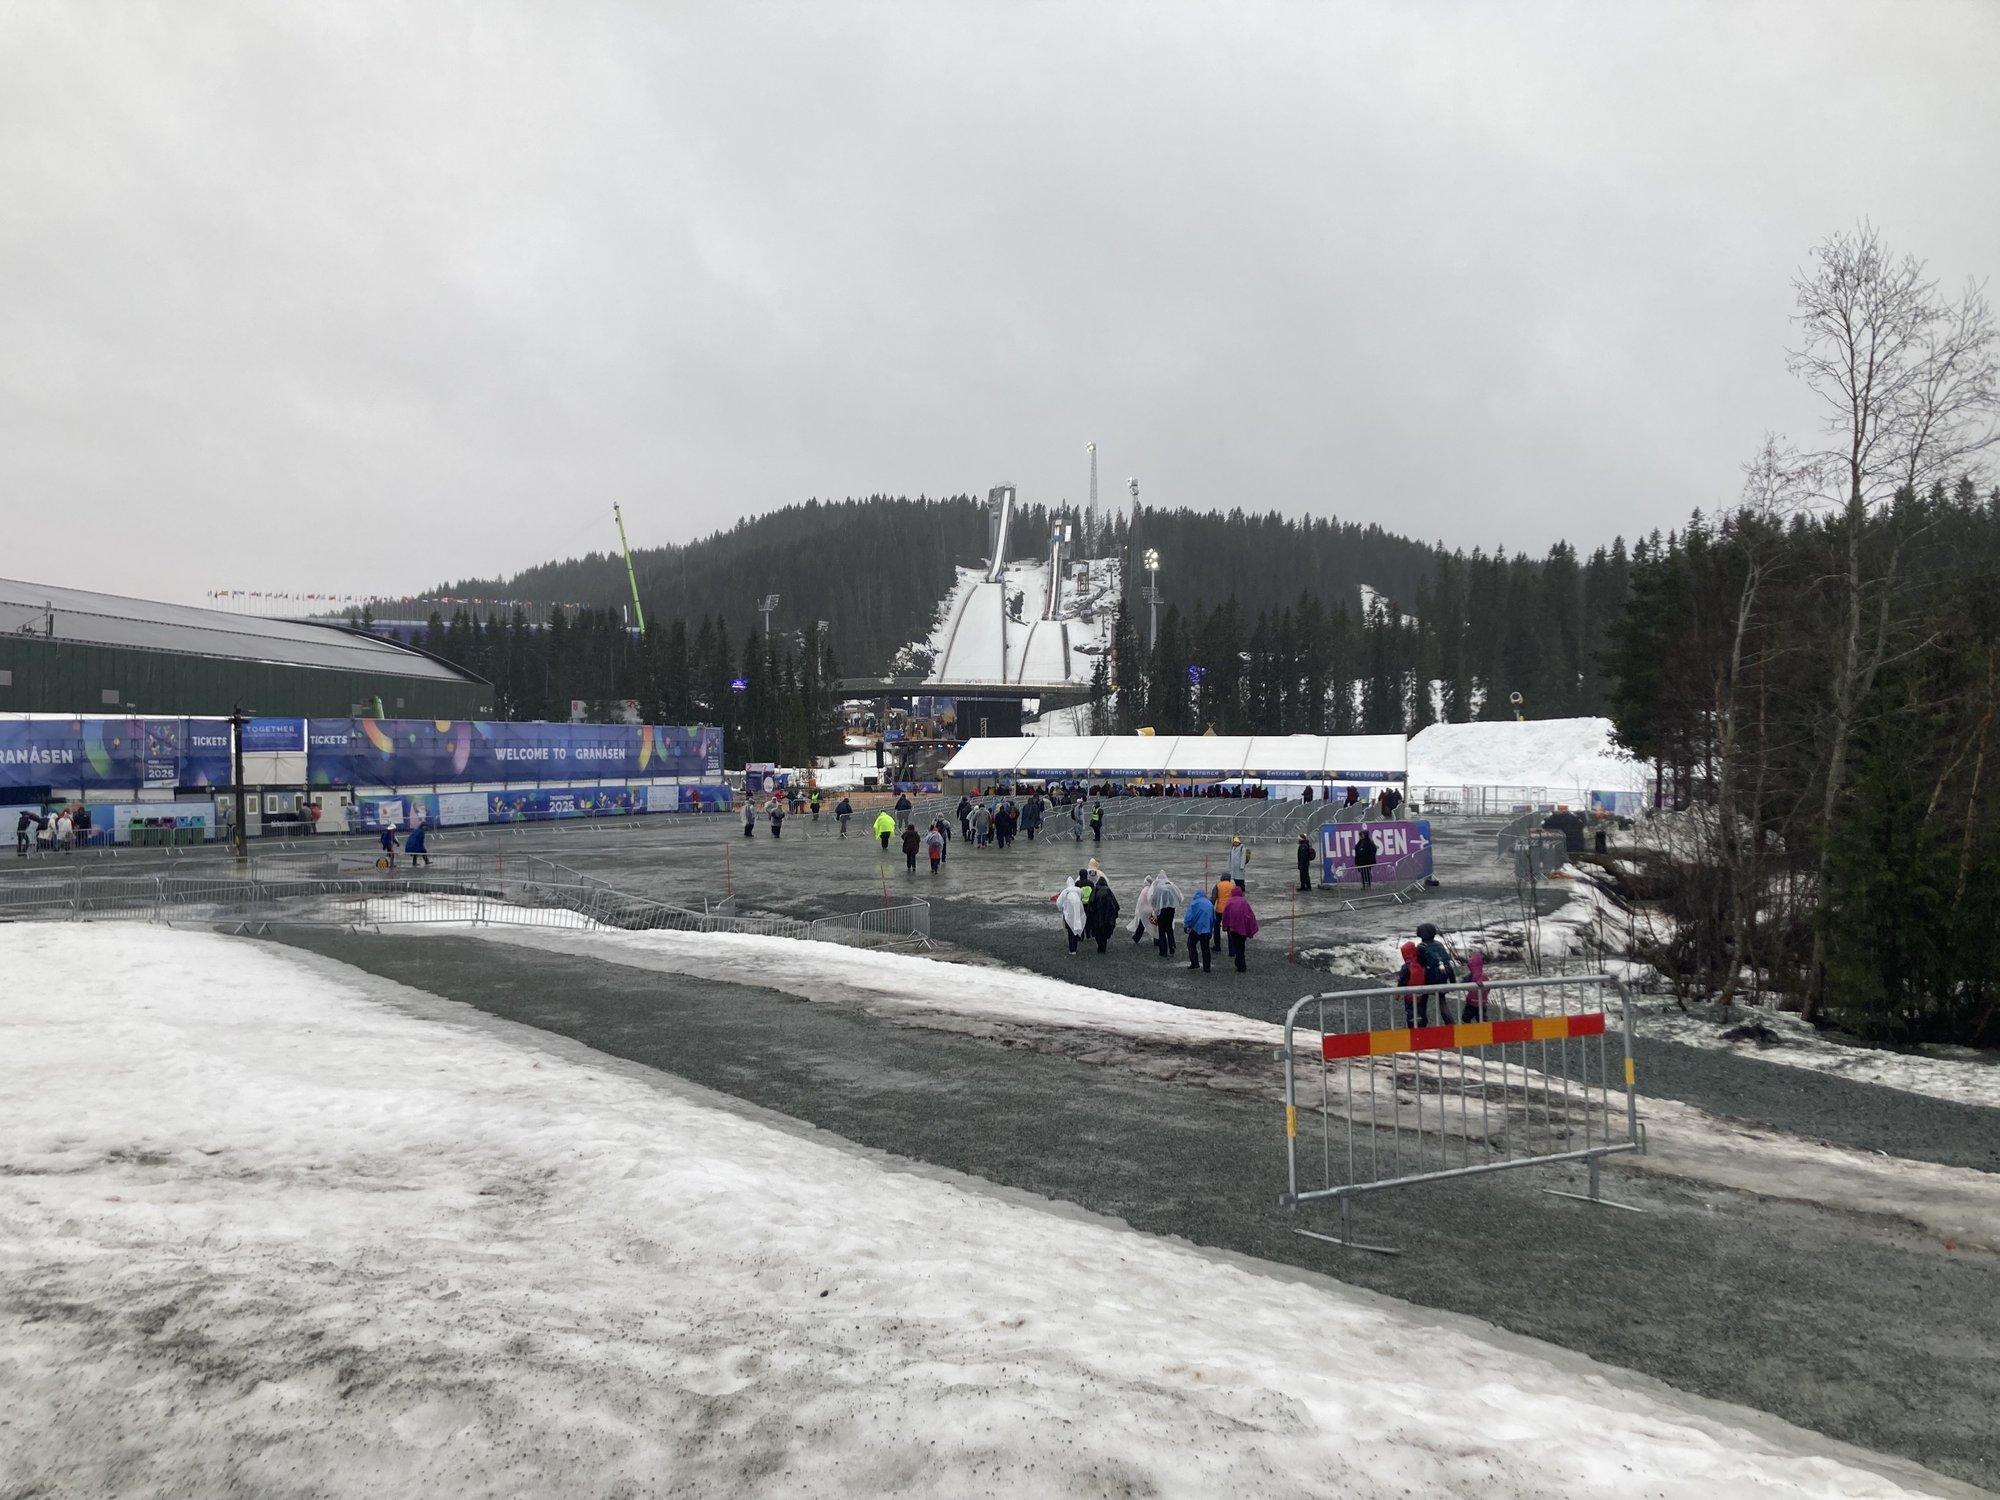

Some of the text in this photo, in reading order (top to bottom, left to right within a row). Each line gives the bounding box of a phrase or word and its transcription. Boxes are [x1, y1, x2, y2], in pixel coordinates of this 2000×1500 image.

[247, 725, 295, 733] TOGETHER
[192, 736, 227, 746] TICKETS
[310, 735, 348, 745] TICKETS
[494, 745, 626, 761] WELCOME TO GRANÅSEN
[148, 769, 175, 778] 2025
[549, 801, 575, 813] 2025
[1324, 823, 1408, 858] LITJSEN
